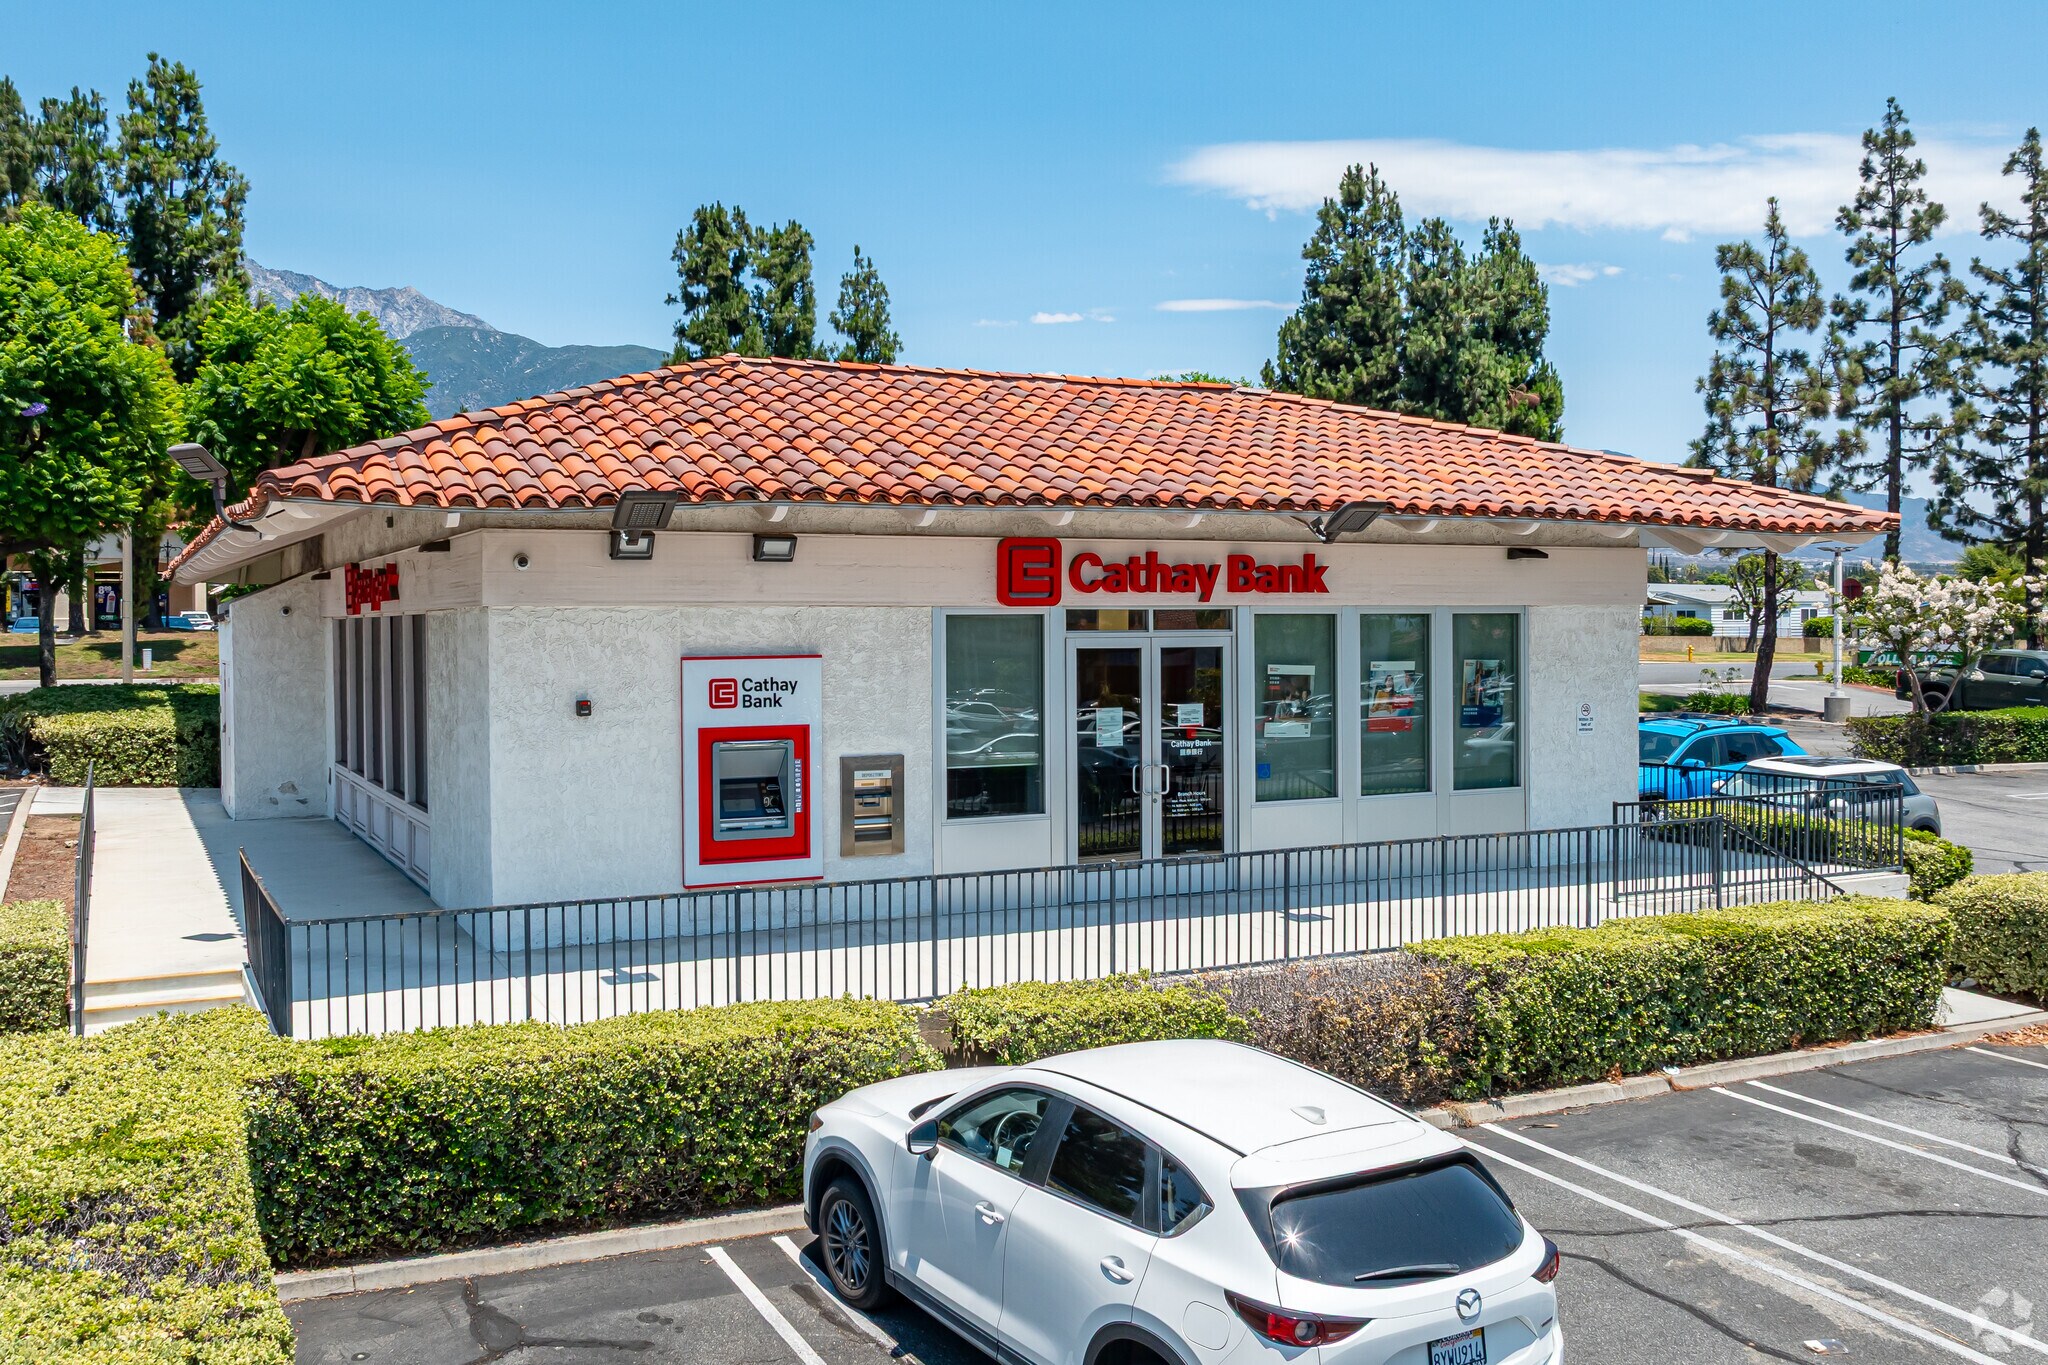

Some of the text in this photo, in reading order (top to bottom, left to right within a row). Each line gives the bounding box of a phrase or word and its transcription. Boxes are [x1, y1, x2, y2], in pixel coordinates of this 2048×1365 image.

[1068, 551, 1329, 602] Cathay Bank
[742, 677, 798, 695] Cathay
[742, 693, 783, 708] Bank
[1171, 739, 1212, 748] Cathay Bank
